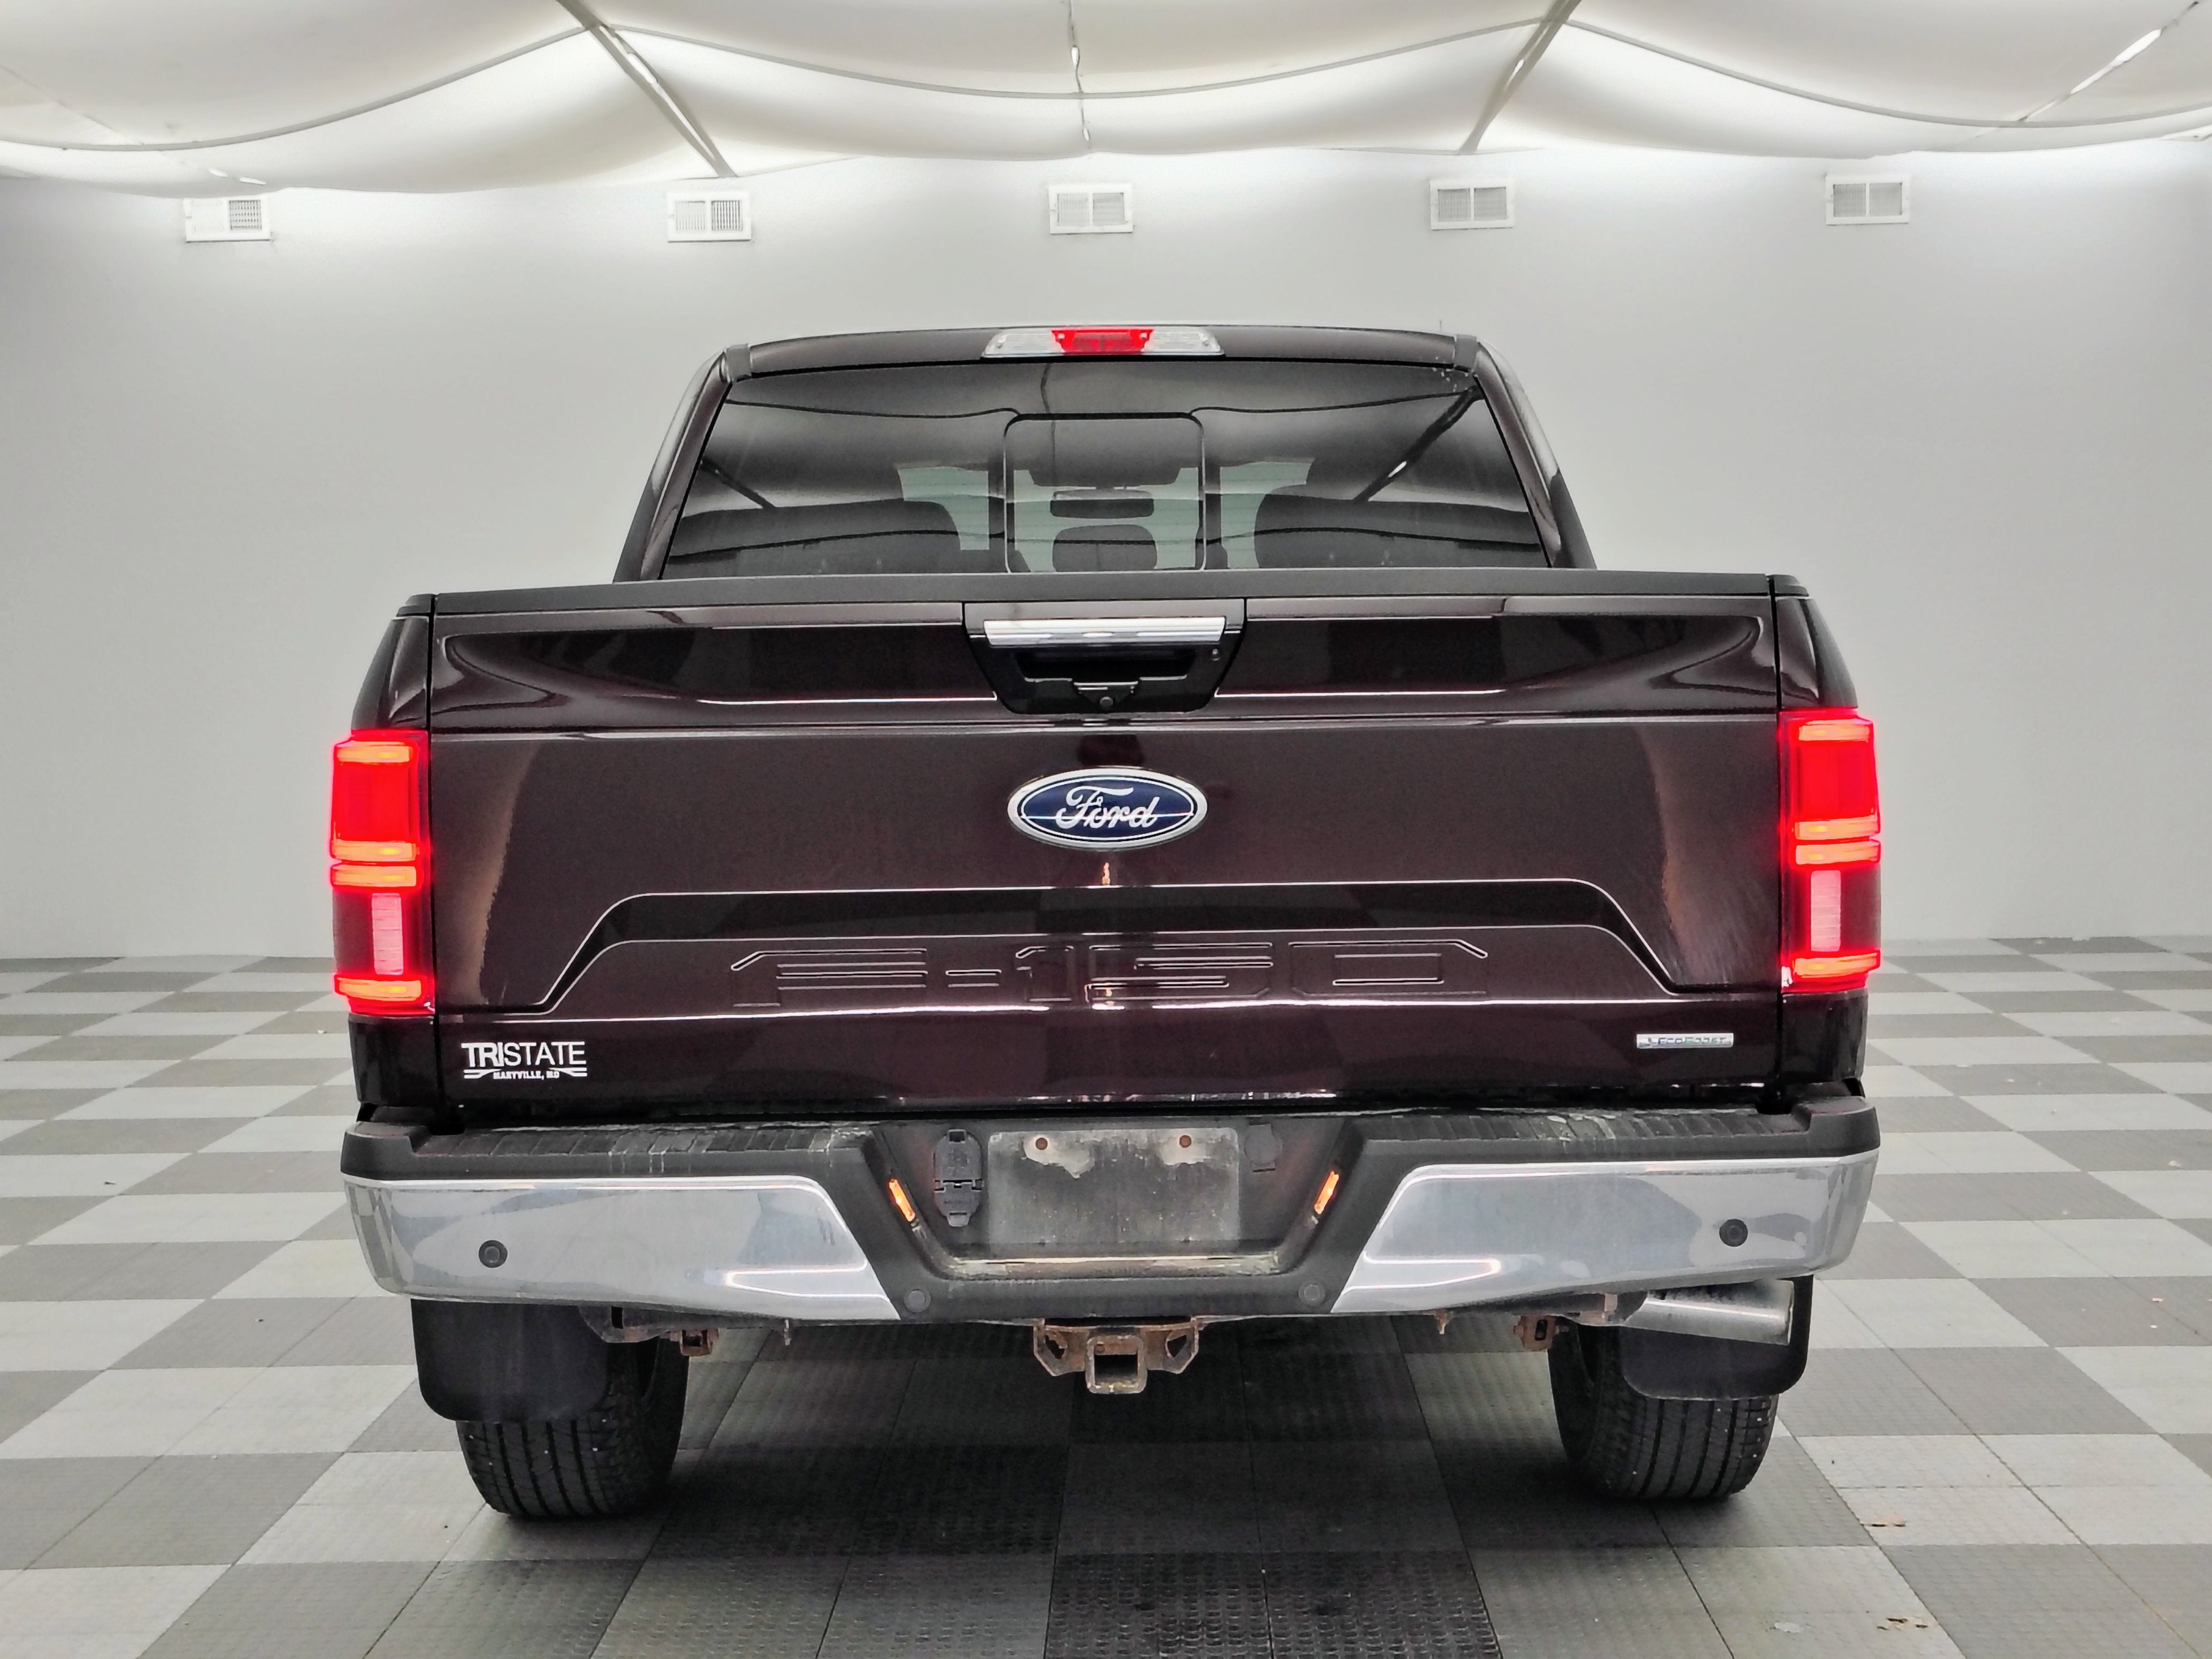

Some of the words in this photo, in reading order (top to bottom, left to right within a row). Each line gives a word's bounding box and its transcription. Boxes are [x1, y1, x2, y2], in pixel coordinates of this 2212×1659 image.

[1056, 786, 1160, 829] Ford
[731, 939, 1488, 1006] F-150
[461, 1041, 587, 1067] TRISTATE
